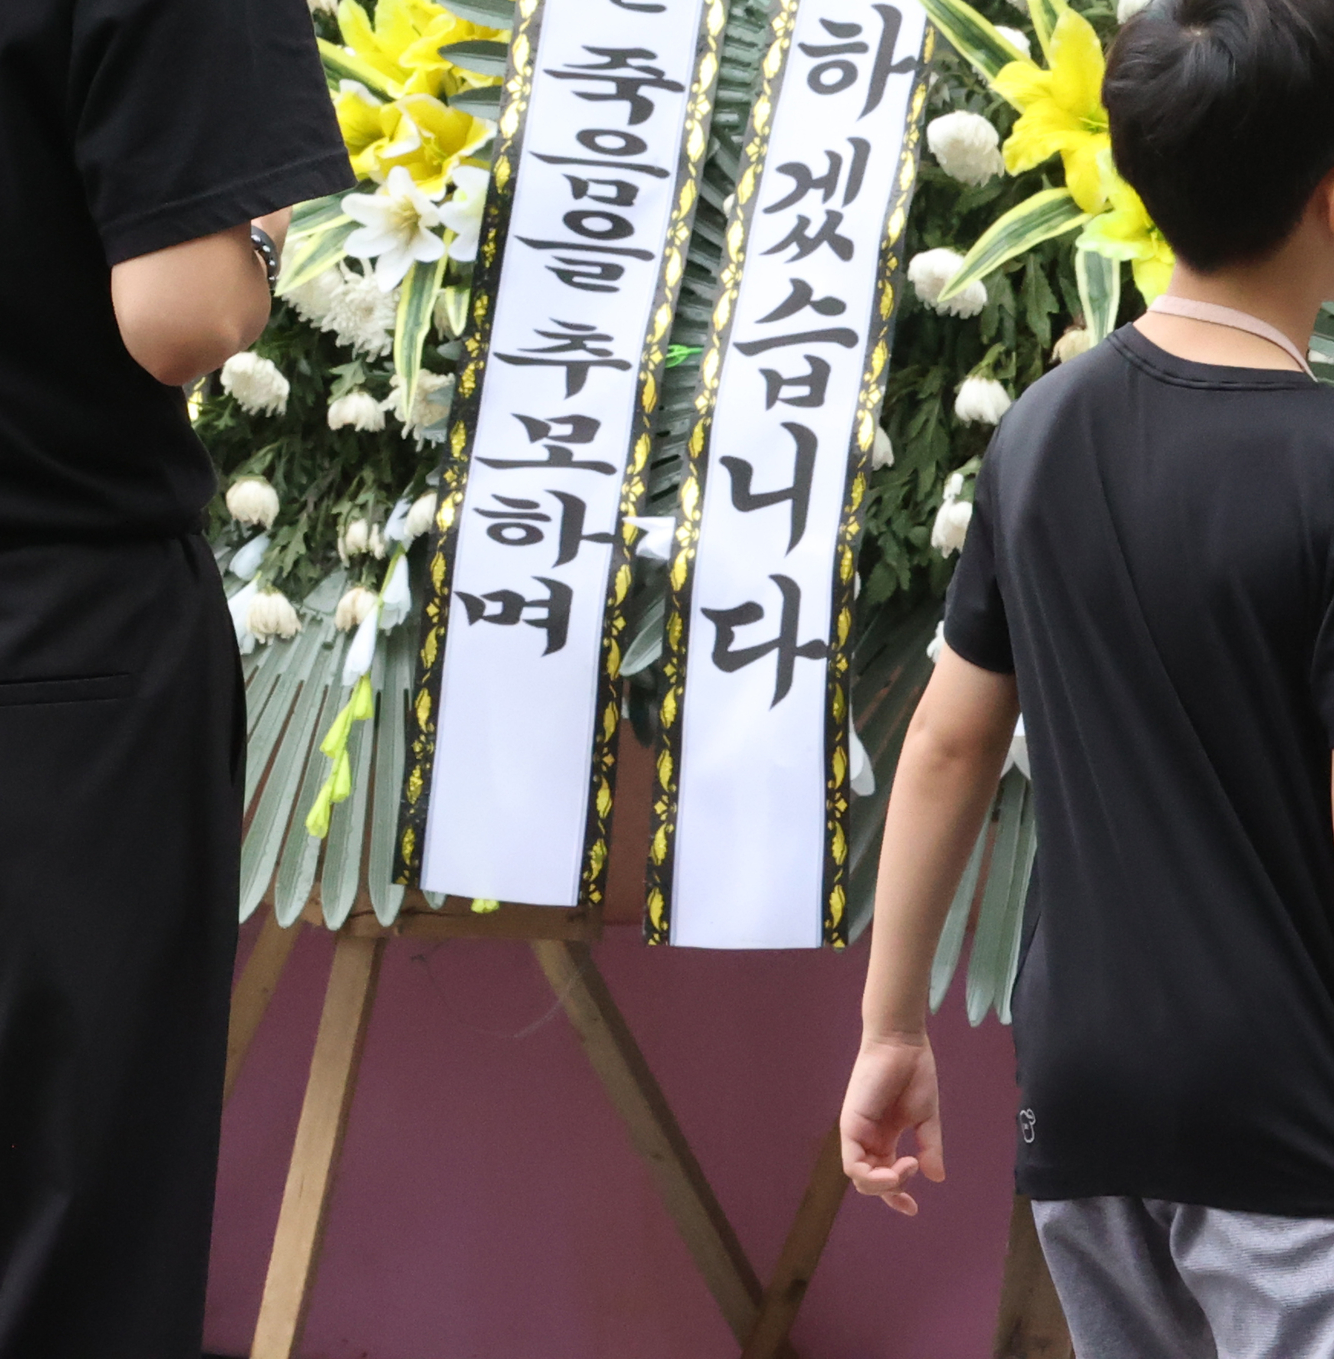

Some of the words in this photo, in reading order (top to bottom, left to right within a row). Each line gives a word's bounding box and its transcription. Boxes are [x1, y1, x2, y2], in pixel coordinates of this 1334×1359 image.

[514, 45, 686, 293] 죽음을
[455, 319, 634, 658] 추모하며
[701, 3, 924, 711] 하겠습니다
